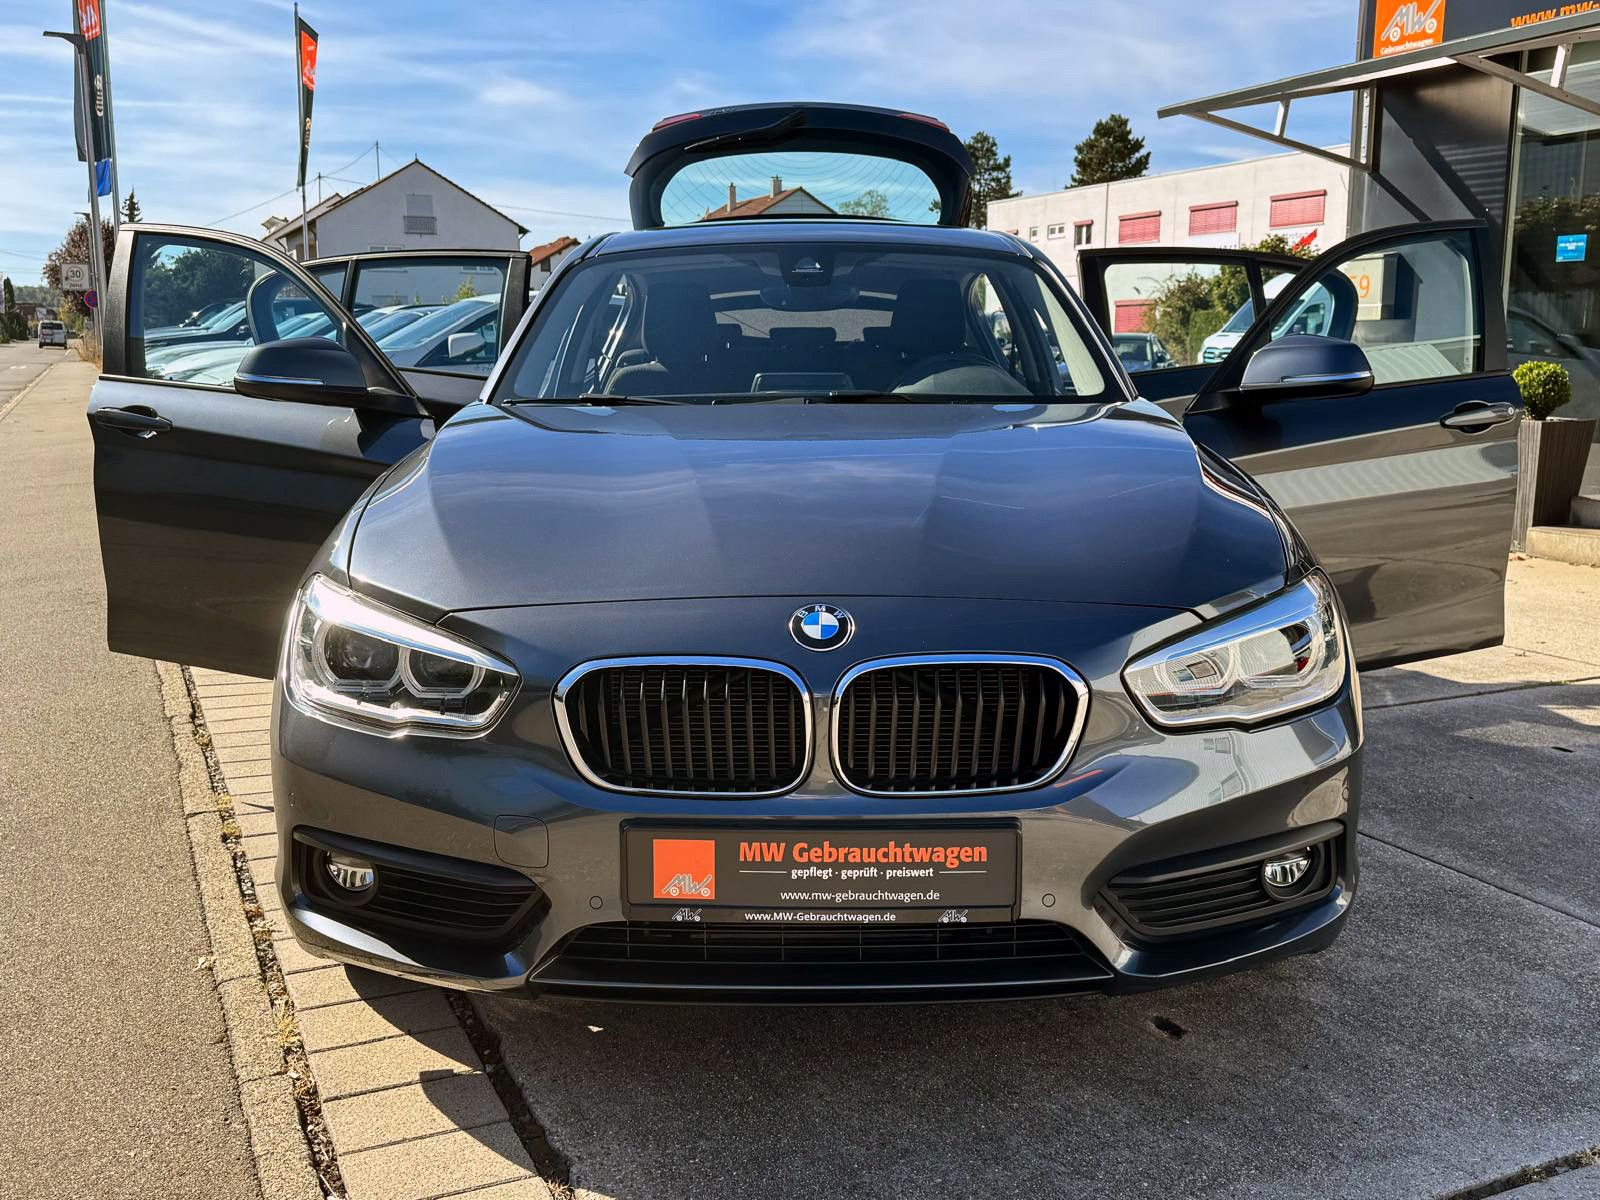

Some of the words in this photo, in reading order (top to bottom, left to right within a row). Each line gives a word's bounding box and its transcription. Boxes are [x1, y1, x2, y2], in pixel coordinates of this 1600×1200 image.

[1510, 1, 1600, 27] wwwmw-
[1379, 37, 1434, 56] Gebrauchtwagen
[70, 270, 81, 278] 30
[796, 604, 846, 619] BMW
[738, 841, 786, 862] MW
[792, 839, 988, 868] Gebrauchtwagen
[790, 866, 833, 880] gepflegt
[840, 866, 878, 880] geprüft
[885, 866, 934, 880] preiswert
[780, 889, 940, 903] www.mw-gebrauchtwagen.de
[744, 911, 897, 923] www.MW-Gebrauchtwagen.de
